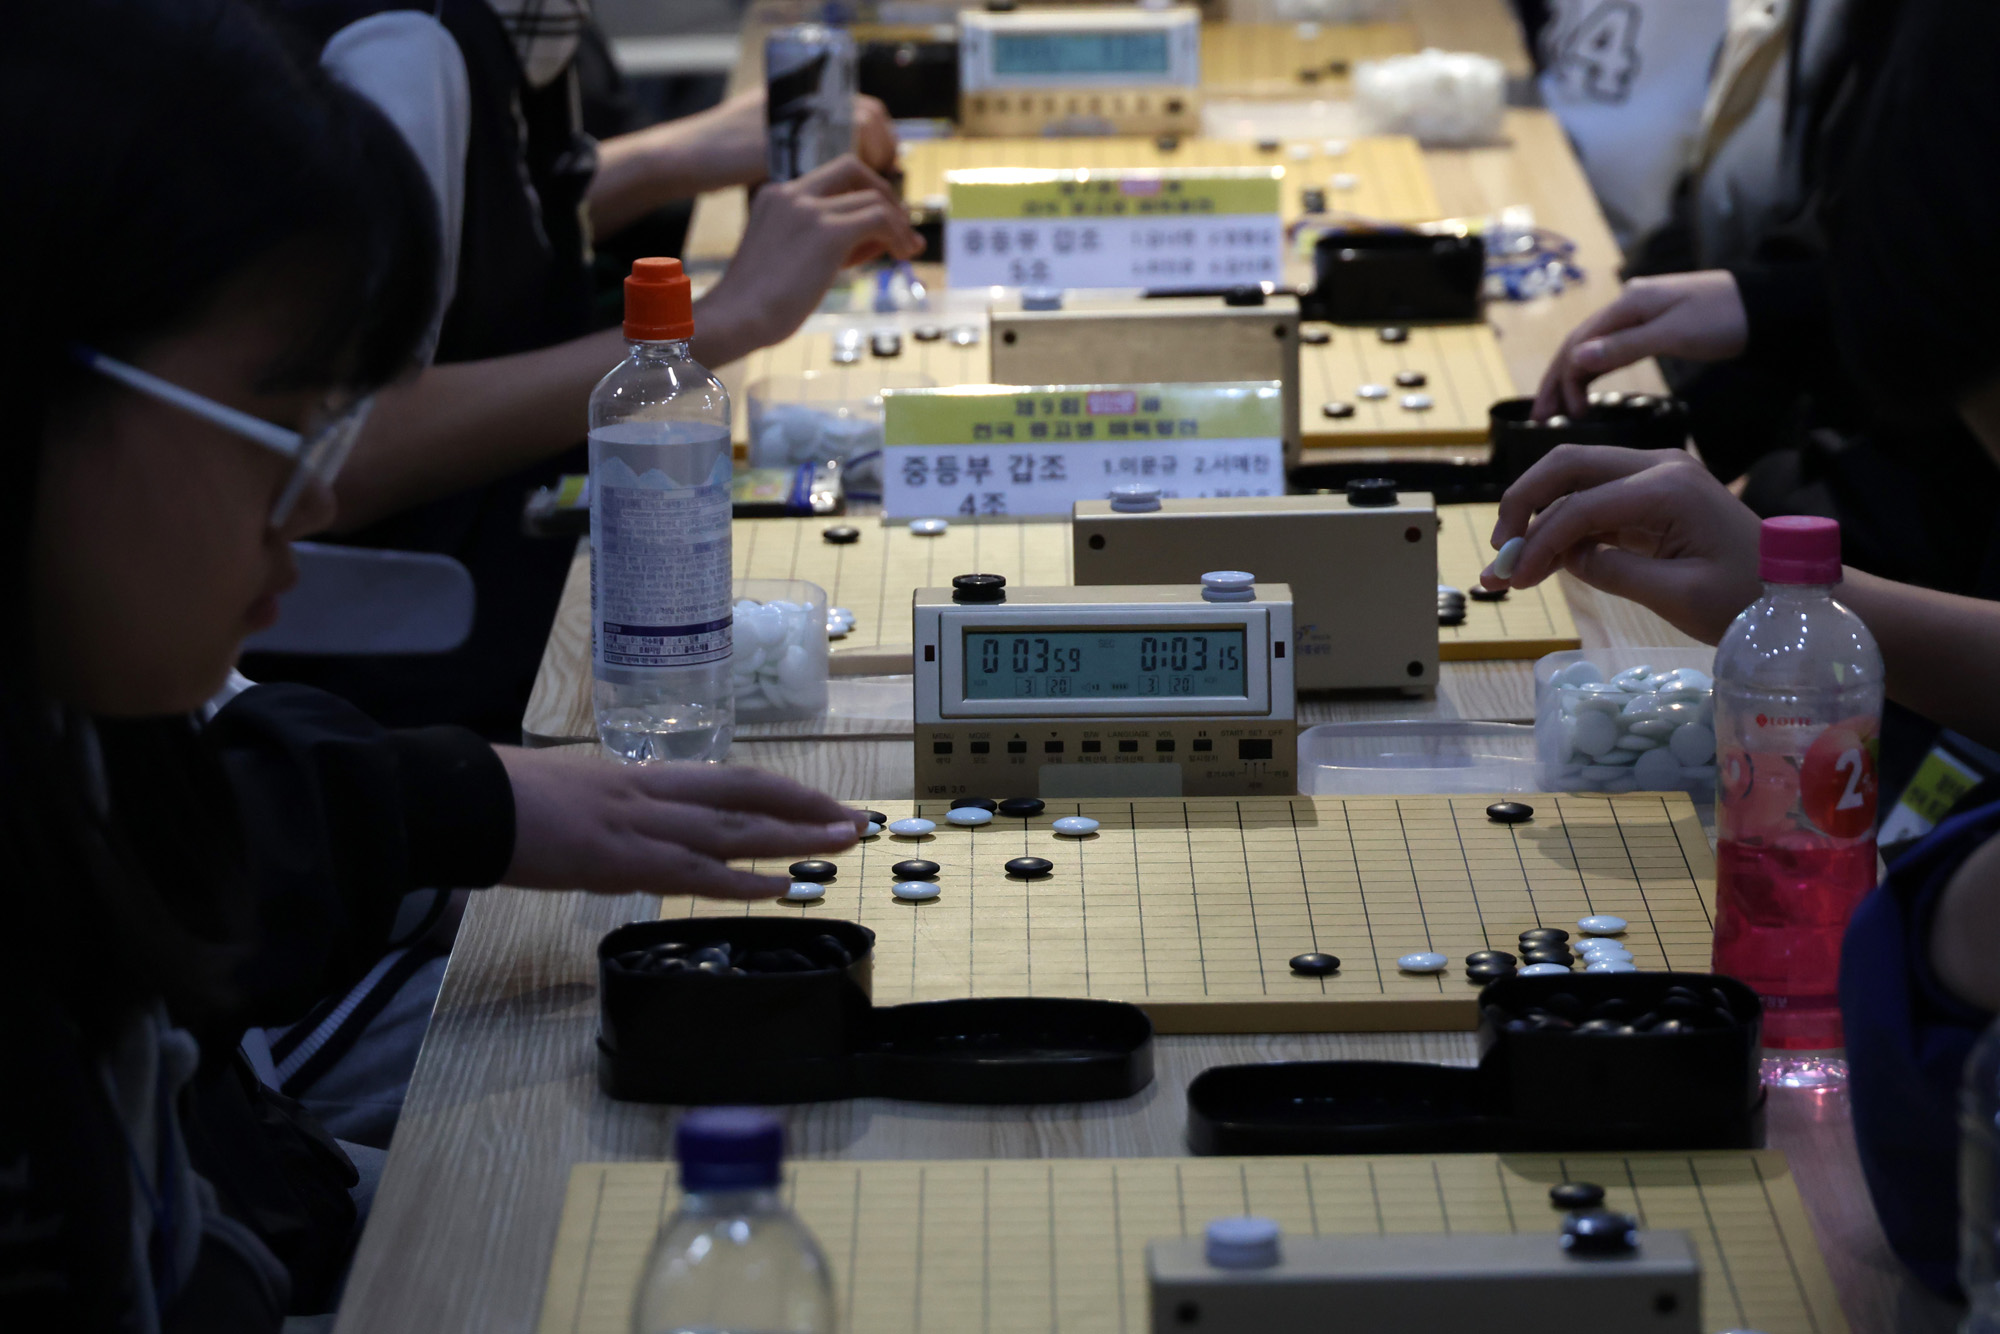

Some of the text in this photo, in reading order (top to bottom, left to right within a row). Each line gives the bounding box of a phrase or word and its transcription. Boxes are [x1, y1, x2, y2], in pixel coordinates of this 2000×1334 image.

[902, 455, 993, 486] 중등부
[1008, 454, 1067, 485] 갑조
[958, 492, 1007, 516] 4조
[932, 732, 954, 740] MENU
[1107, 730, 1150, 738] LANGUAGE
[1158, 730, 1173, 738] VOL
[1220, 729, 1244, 737] START
[1268, 728, 1283, 736] OFF
[928, 785, 947, 794] VER
